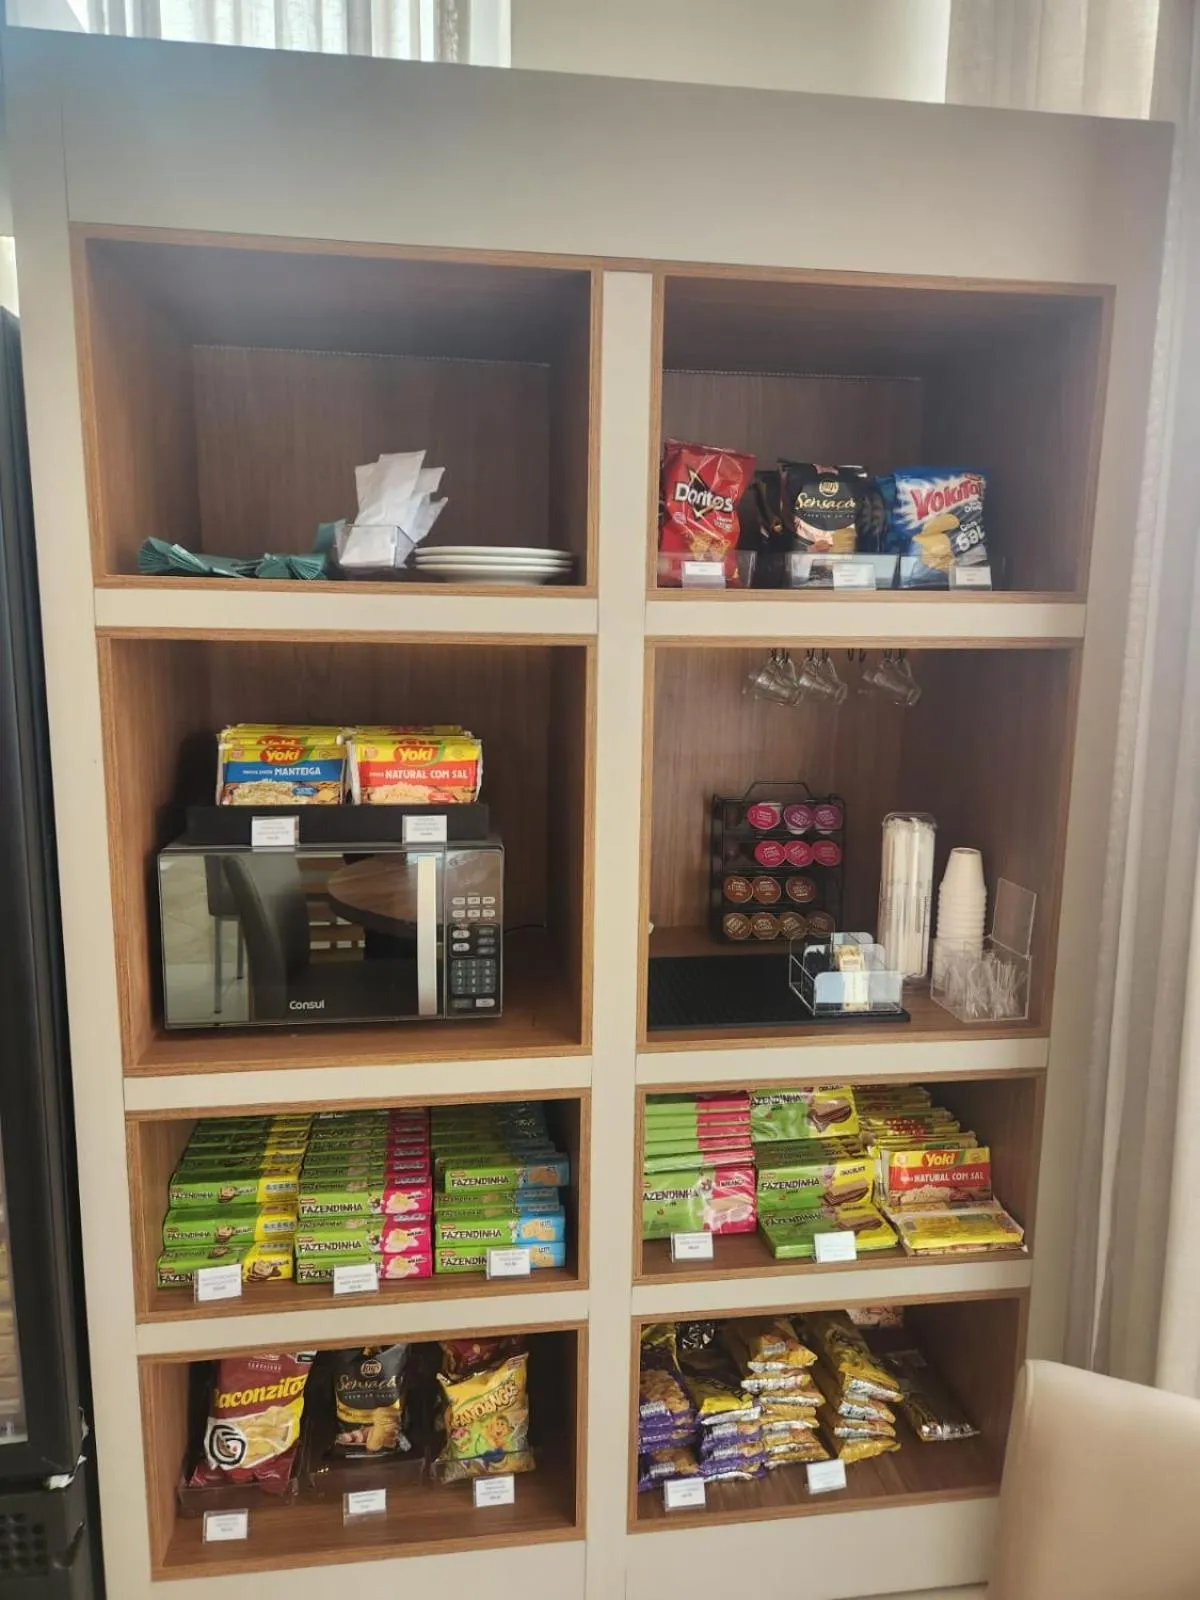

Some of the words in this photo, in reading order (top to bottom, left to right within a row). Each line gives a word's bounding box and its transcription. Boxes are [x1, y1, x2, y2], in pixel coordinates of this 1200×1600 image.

[674, 482, 734, 513] Doritos
[266, 748, 300, 761] Yoki
[399, 747, 434, 762] Yoki
[274, 767, 321, 776] MANTEIGA
[385, 769, 427, 779] NATURAL
[430, 769, 450, 779] COM
[451, 769, 468, 778] SAL
[289, 1000, 325, 1010] Consul
[752, 1092, 803, 1106] AZENDINHA
[925, 1152, 956, 1167] Yoki
[451, 1175, 510, 1187] FAZENDINHA
[914, 1172, 950, 1182] NATURAL
[951, 1171, 969, 1181] COM
[970, 1171, 985, 1181] SAL
[761, 1178, 820, 1191] FAZENDINHA
[644, 1189, 699, 1201] AZENDINHA
[301, 1203, 363, 1215] FAZENDINHA
[441, 1229, 502, 1241] FAZENDINHA
[298, 1240, 362, 1253] FAZENDINHA
[439, 1256, 487, 1267] FAZENDIN
[159, 1272, 194, 1282] FAZEN
[299, 1269, 334, 1280] FAZEN
[214, 1373, 308, 1409] aconzito
